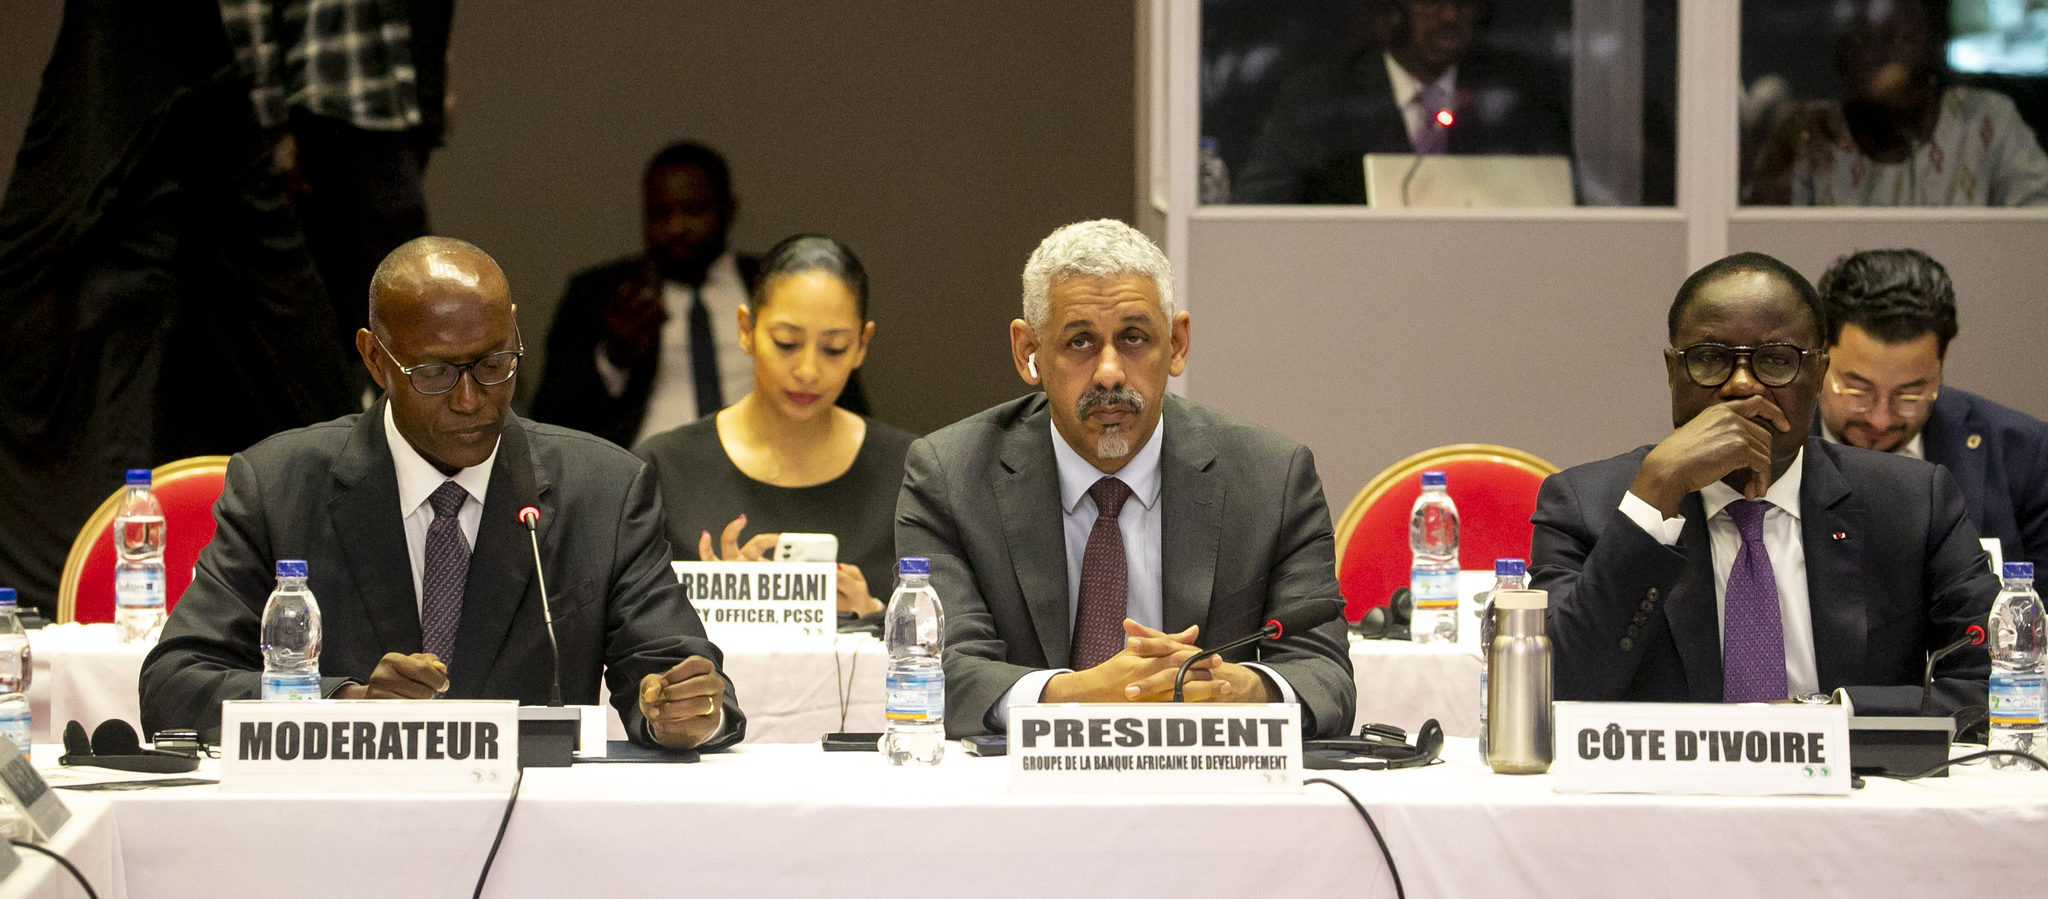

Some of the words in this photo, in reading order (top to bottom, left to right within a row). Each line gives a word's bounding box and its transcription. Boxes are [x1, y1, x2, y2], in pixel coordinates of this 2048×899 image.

[675, 572, 752, 601] RBARA
[757, 573, 827, 601] BEJANI
[715, 608, 780, 624] OFFICER,
[783, 608, 825, 624] PCSC
[238, 720, 499, 761] MODERATEUR
[1021, 717, 1290, 748] PRESIDENT
[1577, 722, 1667, 761] CÔTE
[1675, 730, 1826, 764] D'IVOIRE
[1022, 755, 1063, 771] GROUPE
[1065, 755, 1078, 771] DE
[1080, 755, 1092, 771] LA
[1094, 755, 1135, 772] BANQUE
[1136, 755, 1190, 771] AFRICAINE
[1191, 755, 1204, 771] DE
[1205, 755, 1288, 771] DEVELOPPEMENT
